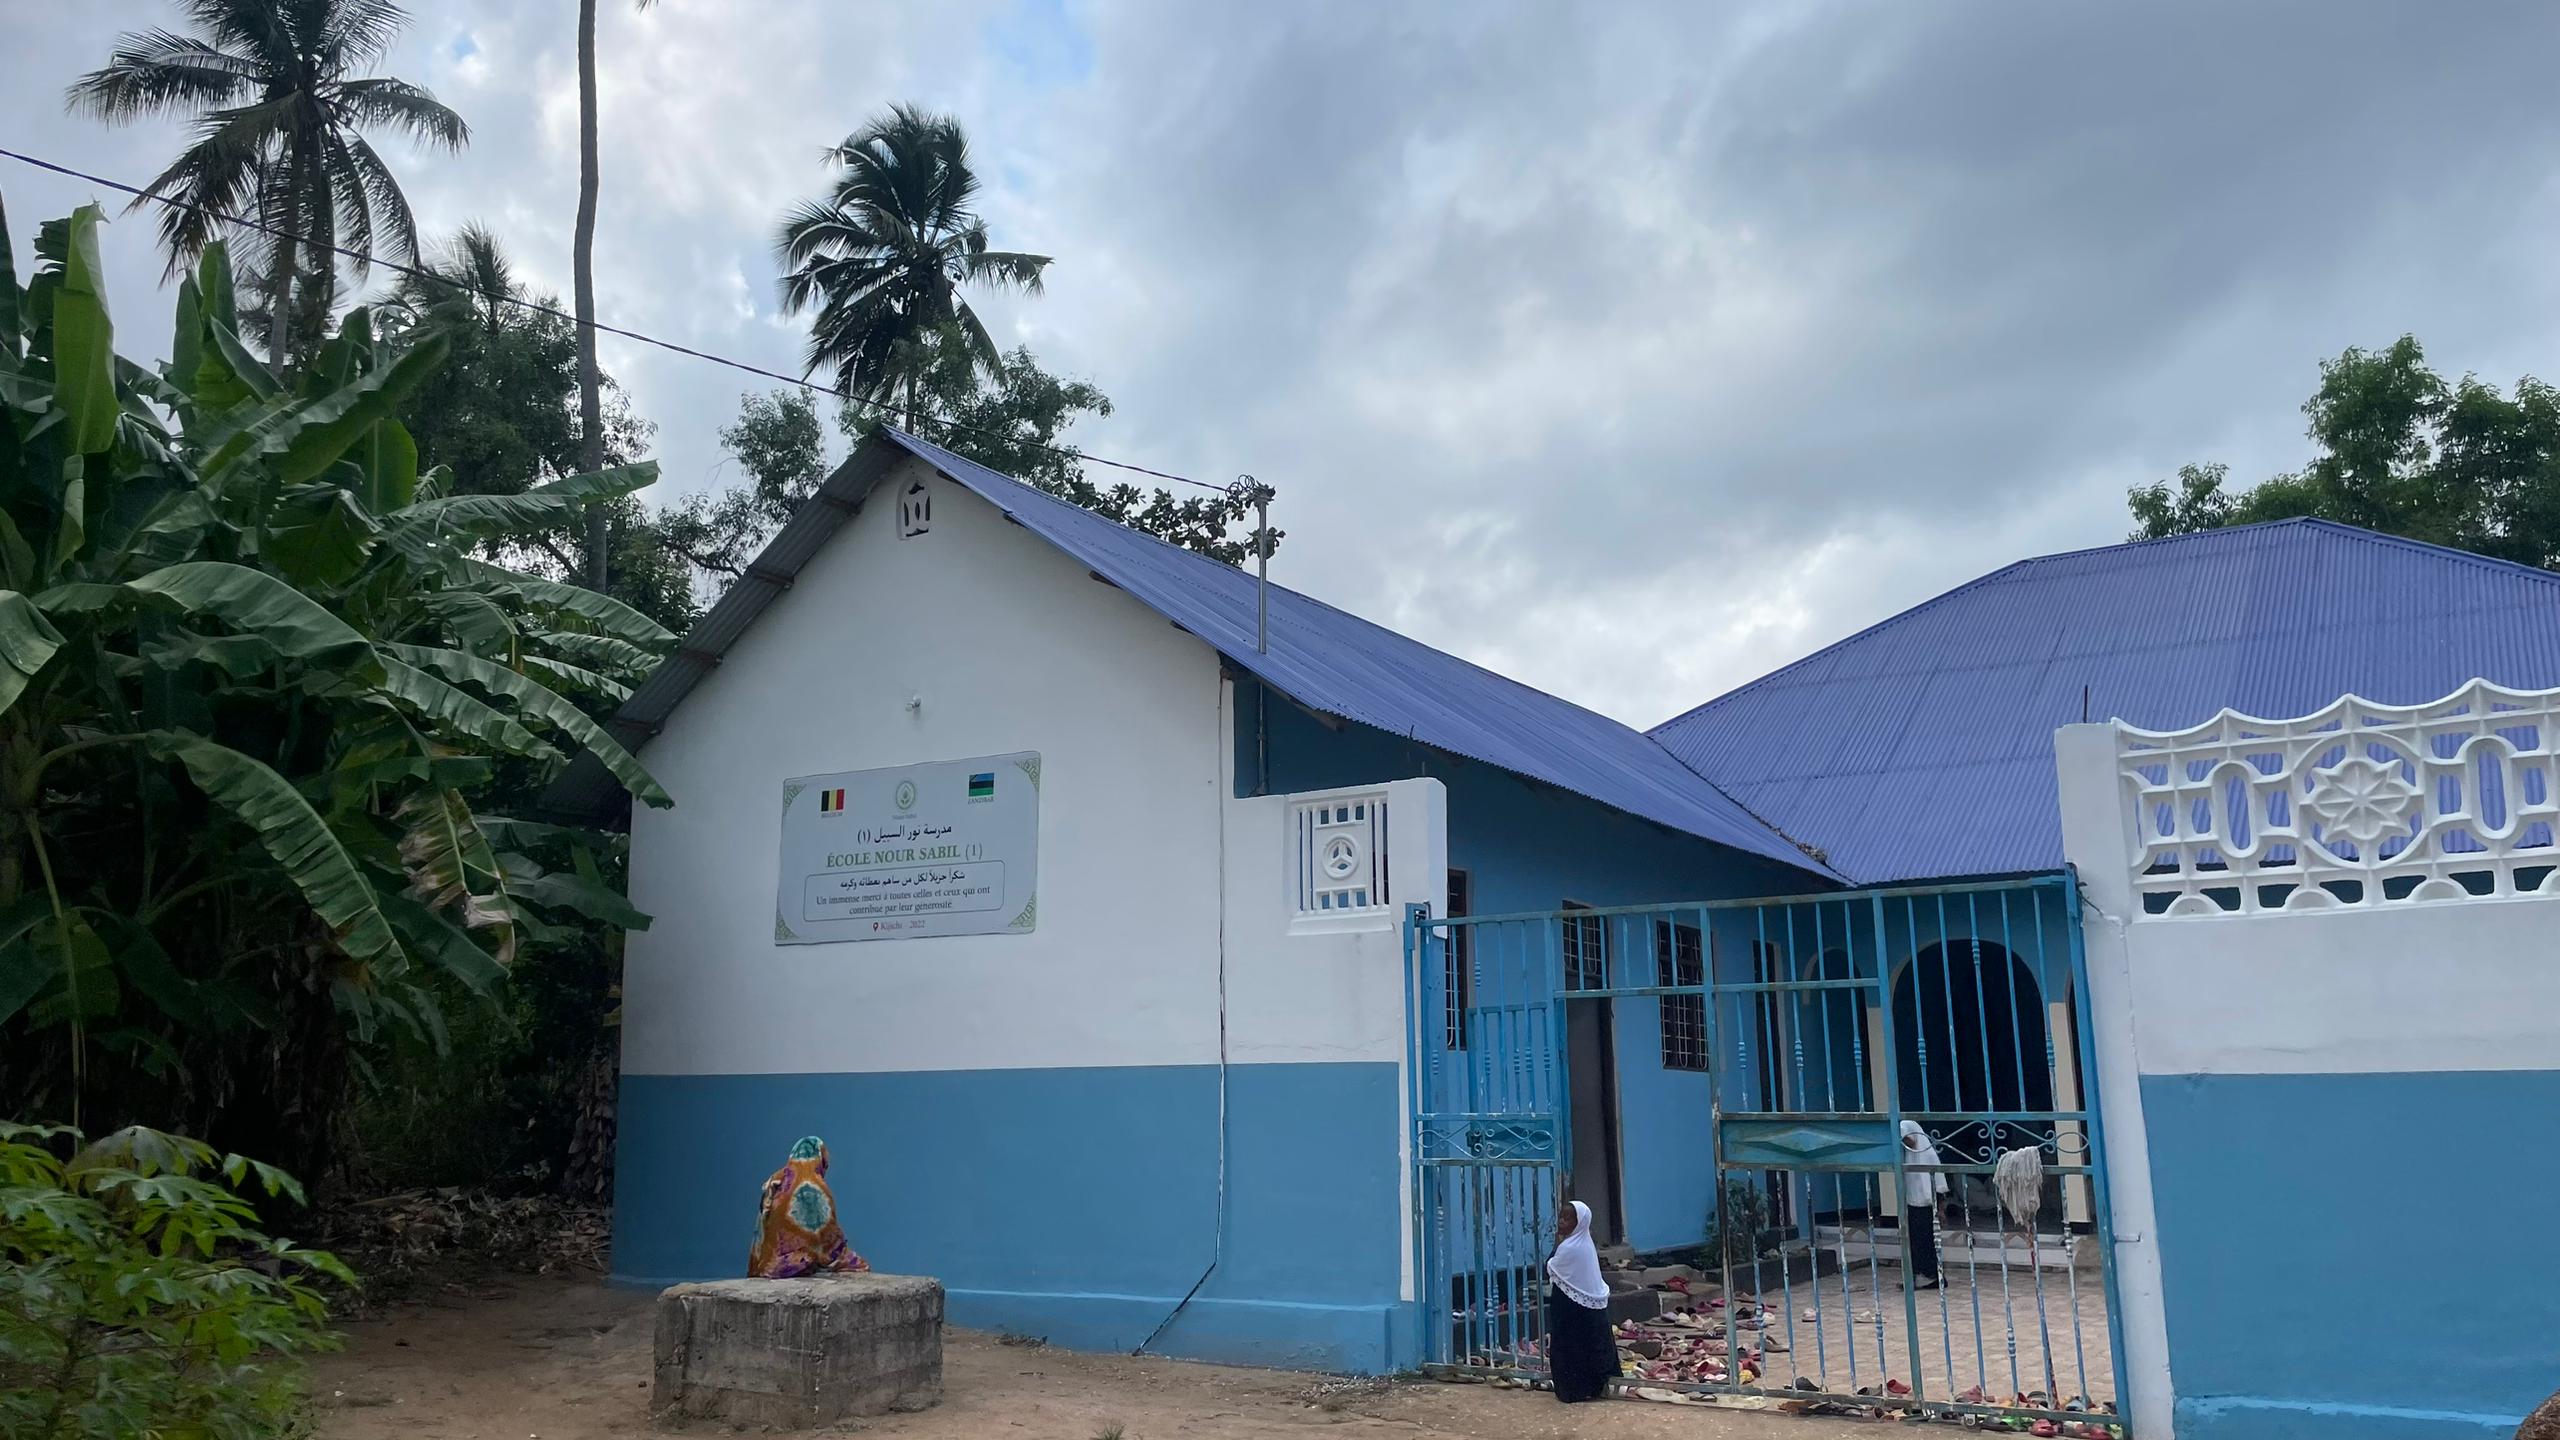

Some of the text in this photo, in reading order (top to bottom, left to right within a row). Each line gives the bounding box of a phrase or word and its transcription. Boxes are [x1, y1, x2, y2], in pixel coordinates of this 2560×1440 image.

[874, 825, 905, 843] السبيل
[907, 826, 921, 841] نور
[923, 824, 952, 839] مدرسة
[826, 843, 983, 868] ÉCOLE NOUR SABIL (1)
[882, 875, 900, 886] ساهم
[902, 876, 912, 886] من
[913, 872, 928, 885] لكل
[816, 896, 827, 905] Un
[828, 895, 860, 904] immense
[861, 893, 881, 903] merci
[889, 891, 912, 901] toutes
[913, 888, 932, 898] celles
[962, 887, 975, 898] qui
[977, 886, 990, 894] ont
[884, 904, 897, 915] par
[898, 902, 913, 912] leur
[909, 919, 925, 928] 2022
